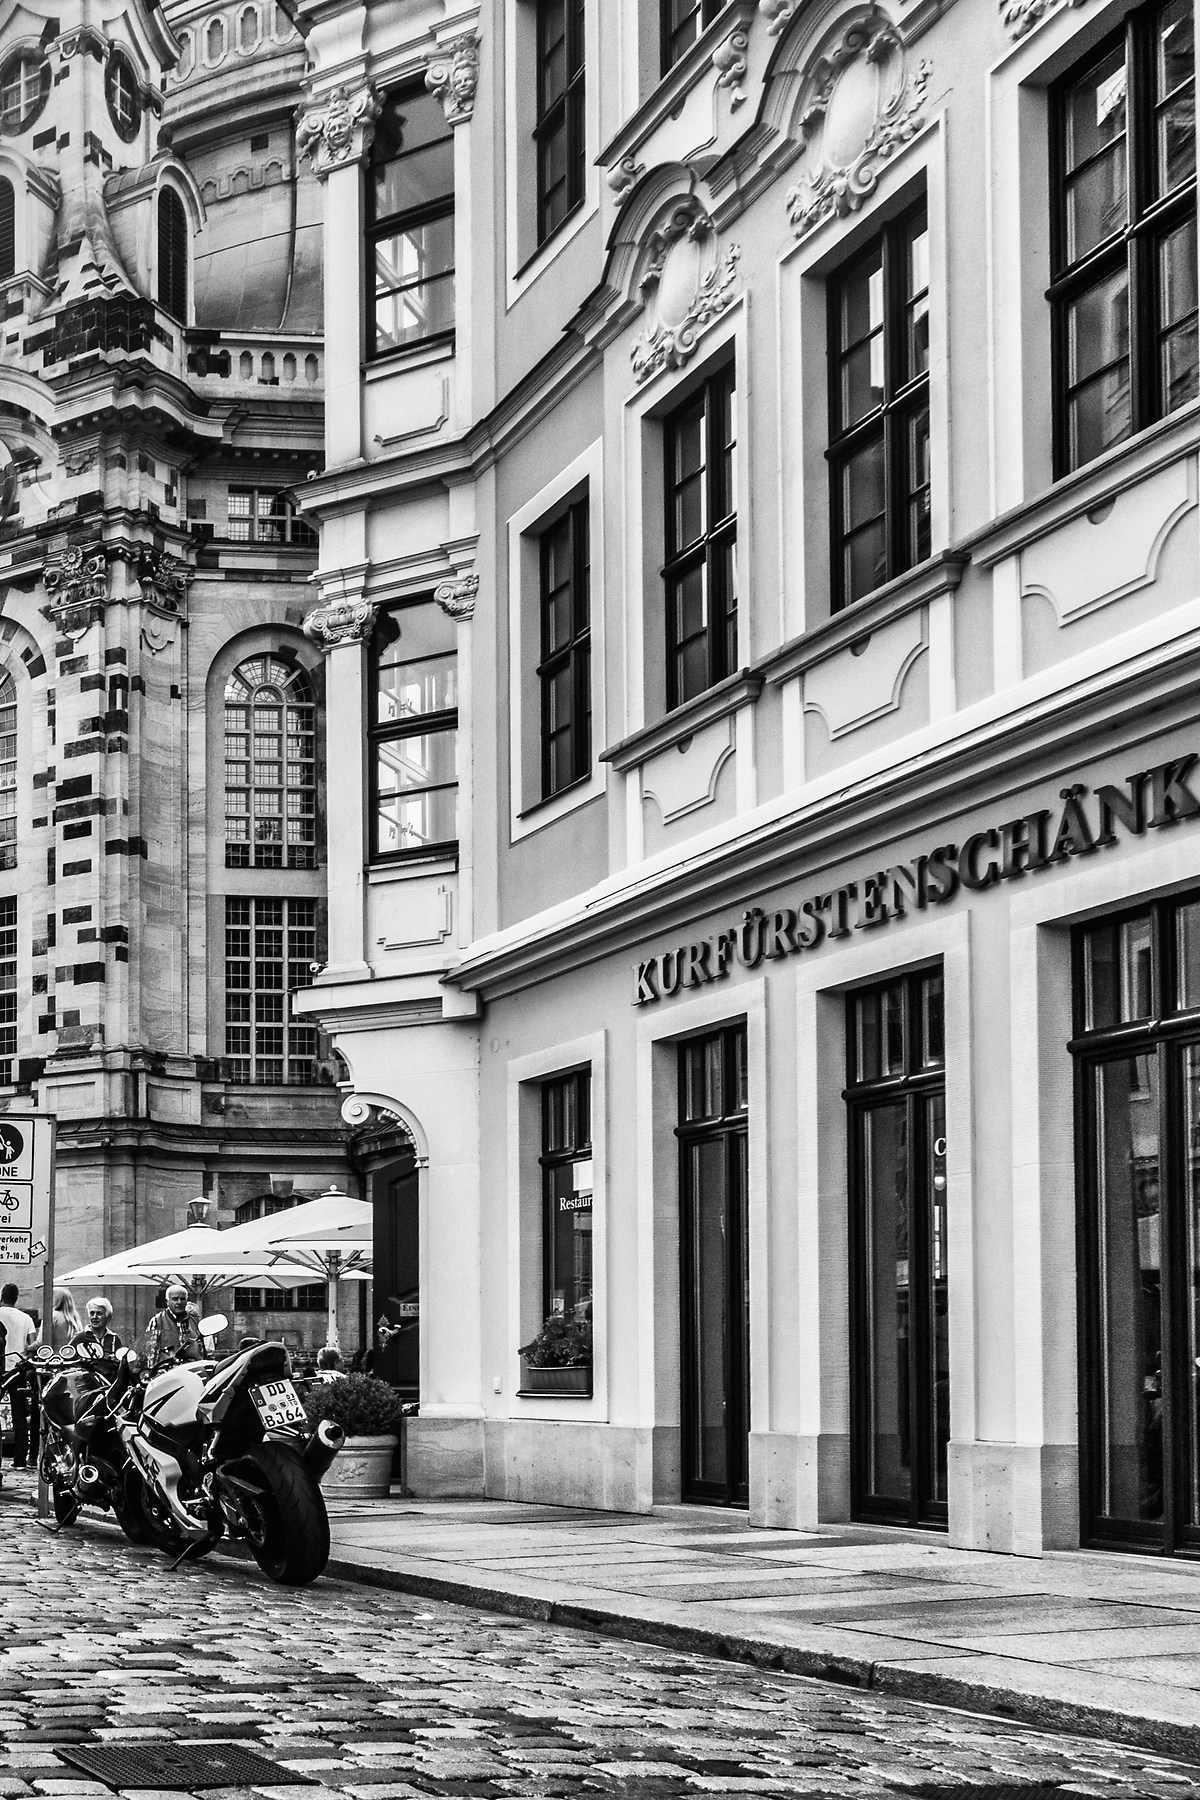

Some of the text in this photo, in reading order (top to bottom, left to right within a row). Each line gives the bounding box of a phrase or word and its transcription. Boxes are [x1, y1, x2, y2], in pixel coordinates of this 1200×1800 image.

[631, 752, 1200, 1006] KURFÜRSTENSCHÄNK
[6, 1252, 20, 1260] 7-10
[266, 1382, 286, 1397] DD
